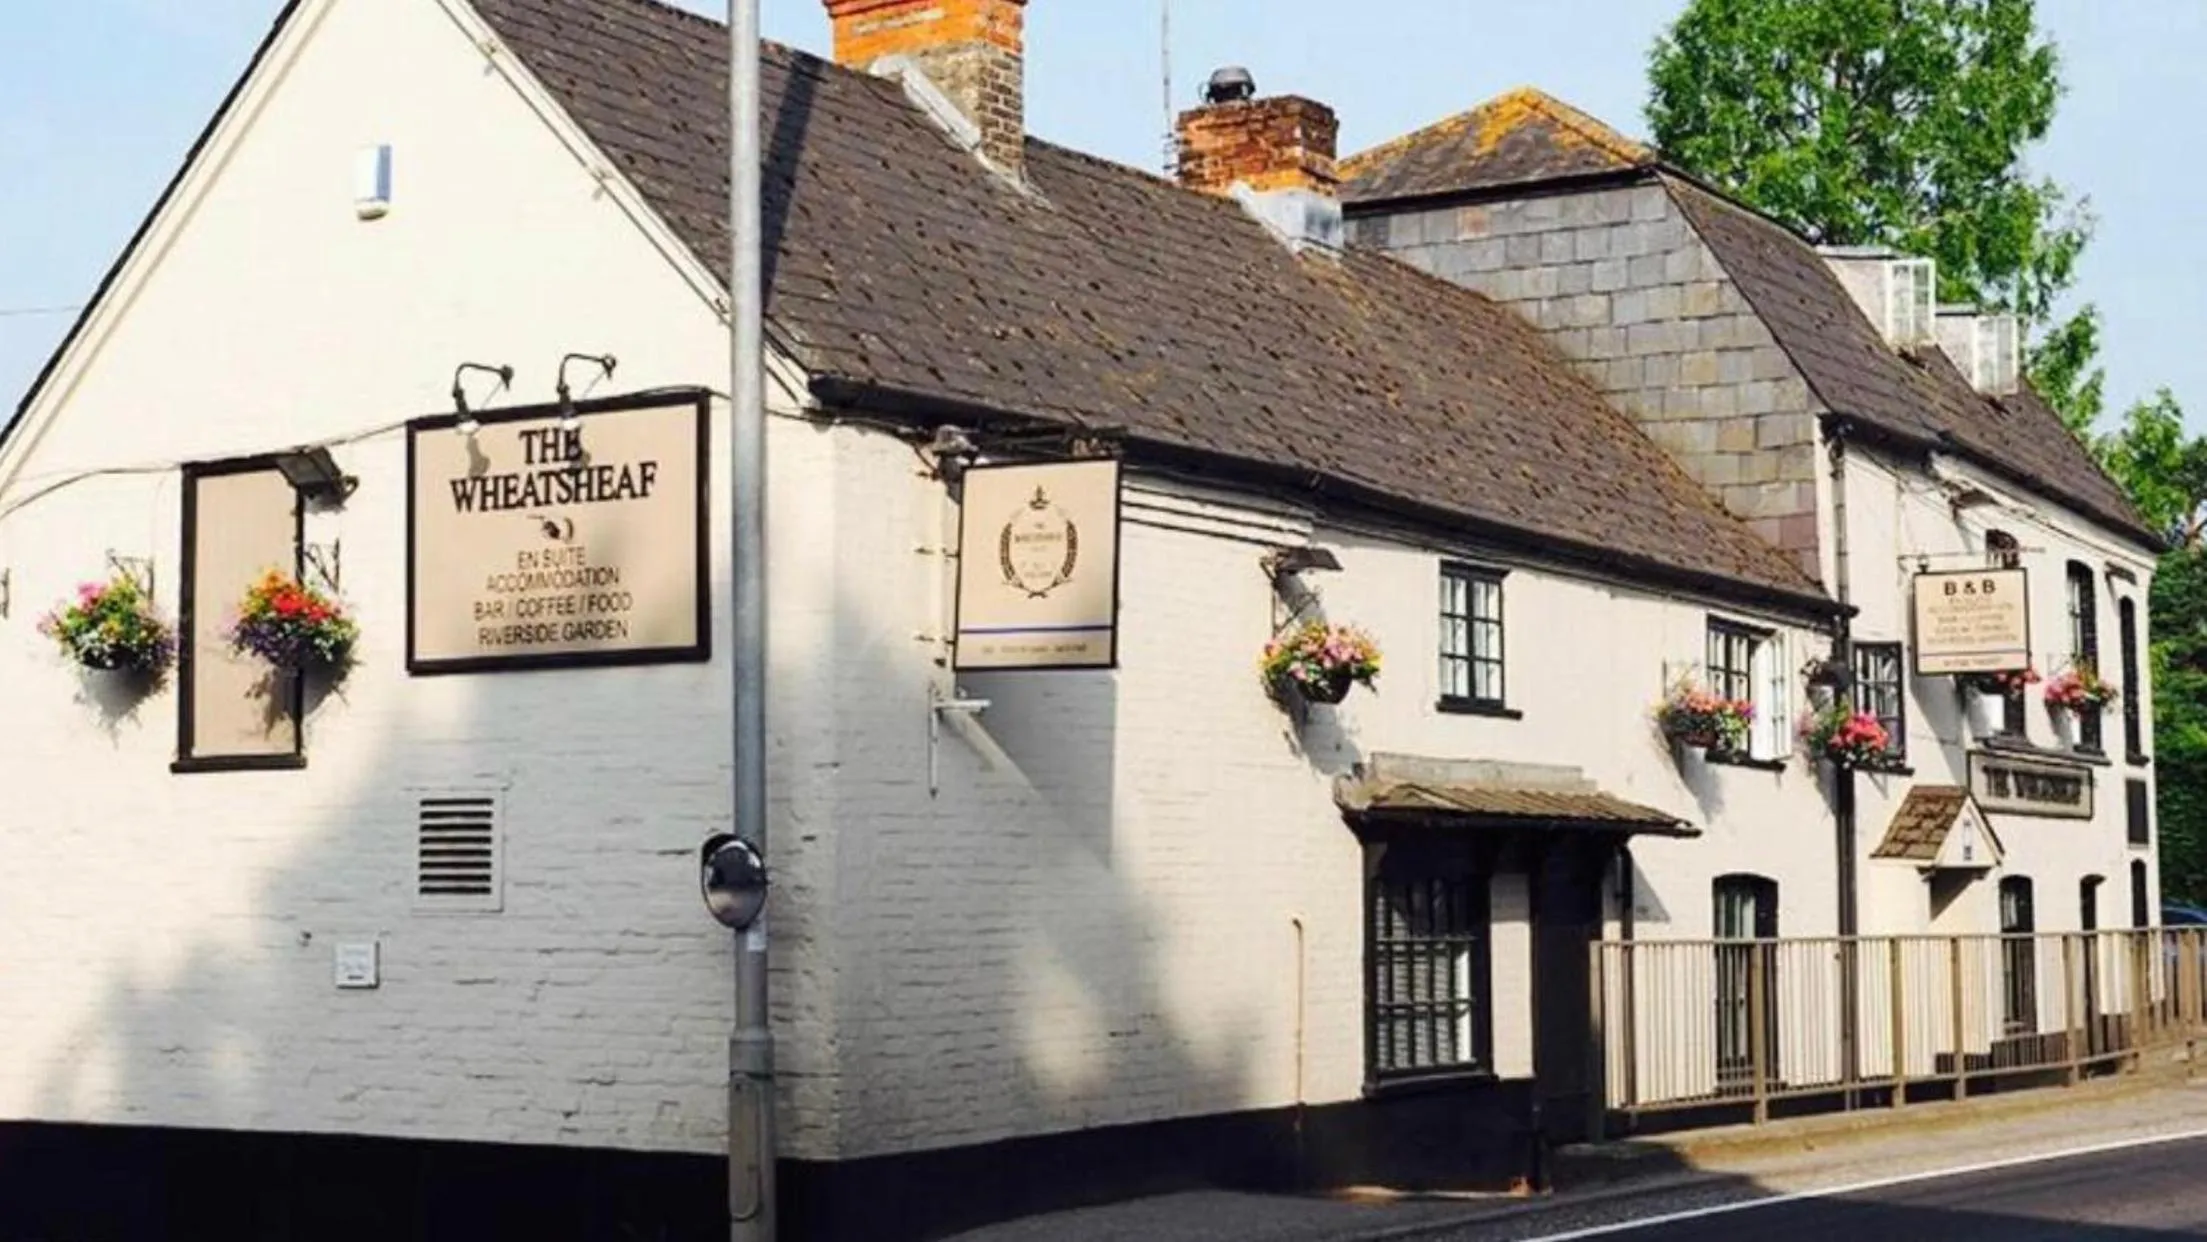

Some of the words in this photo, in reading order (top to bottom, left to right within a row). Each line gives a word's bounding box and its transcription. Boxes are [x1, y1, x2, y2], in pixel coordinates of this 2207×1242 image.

[519, 426, 582, 464] THE
[450, 461, 658, 513] WHEATSHEAF
[518, 550, 539, 569] EN
[543, 546, 585, 568] SUITE
[486, 566, 620, 593] ACCOMMODATION
[1944, 581, 1957, 596] B
[1963, 581, 1976, 595] &
[1982, 579, 1996, 594] B
[474, 600, 504, 621] BAR
[516, 594, 575, 618] COFFEE
[588, 591, 633, 613] FOOD
[479, 622, 559, 645] RIVERSIDE
[562, 619, 630, 641] GARDEN
